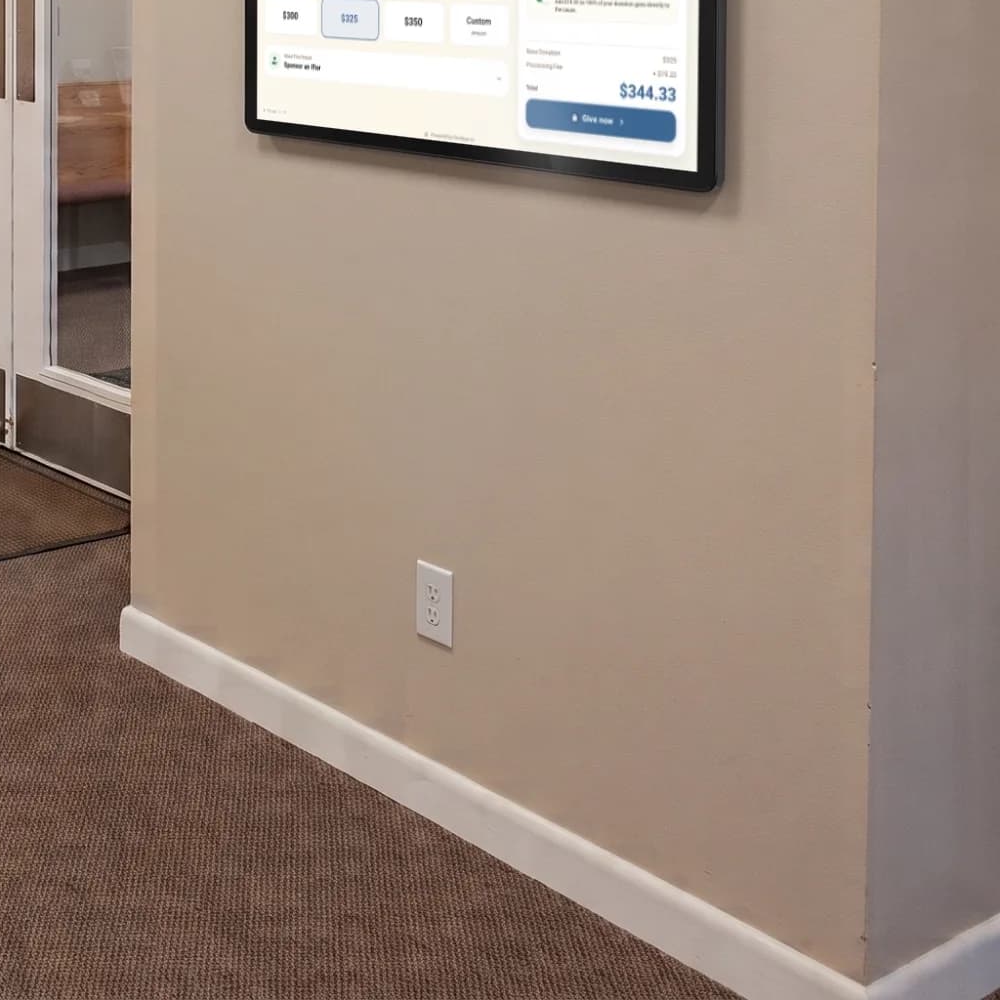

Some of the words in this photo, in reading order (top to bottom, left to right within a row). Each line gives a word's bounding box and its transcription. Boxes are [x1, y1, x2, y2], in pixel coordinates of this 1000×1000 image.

[283, 10, 299, 20] $300
[341, 13, 358, 24] $325
[404, 16, 423, 27] $350
[466, 16, 492, 26] Custom
[619, 81, 677, 102] $344.33
[582, 113, 597, 124] Give
[599, 117, 614, 126] now
